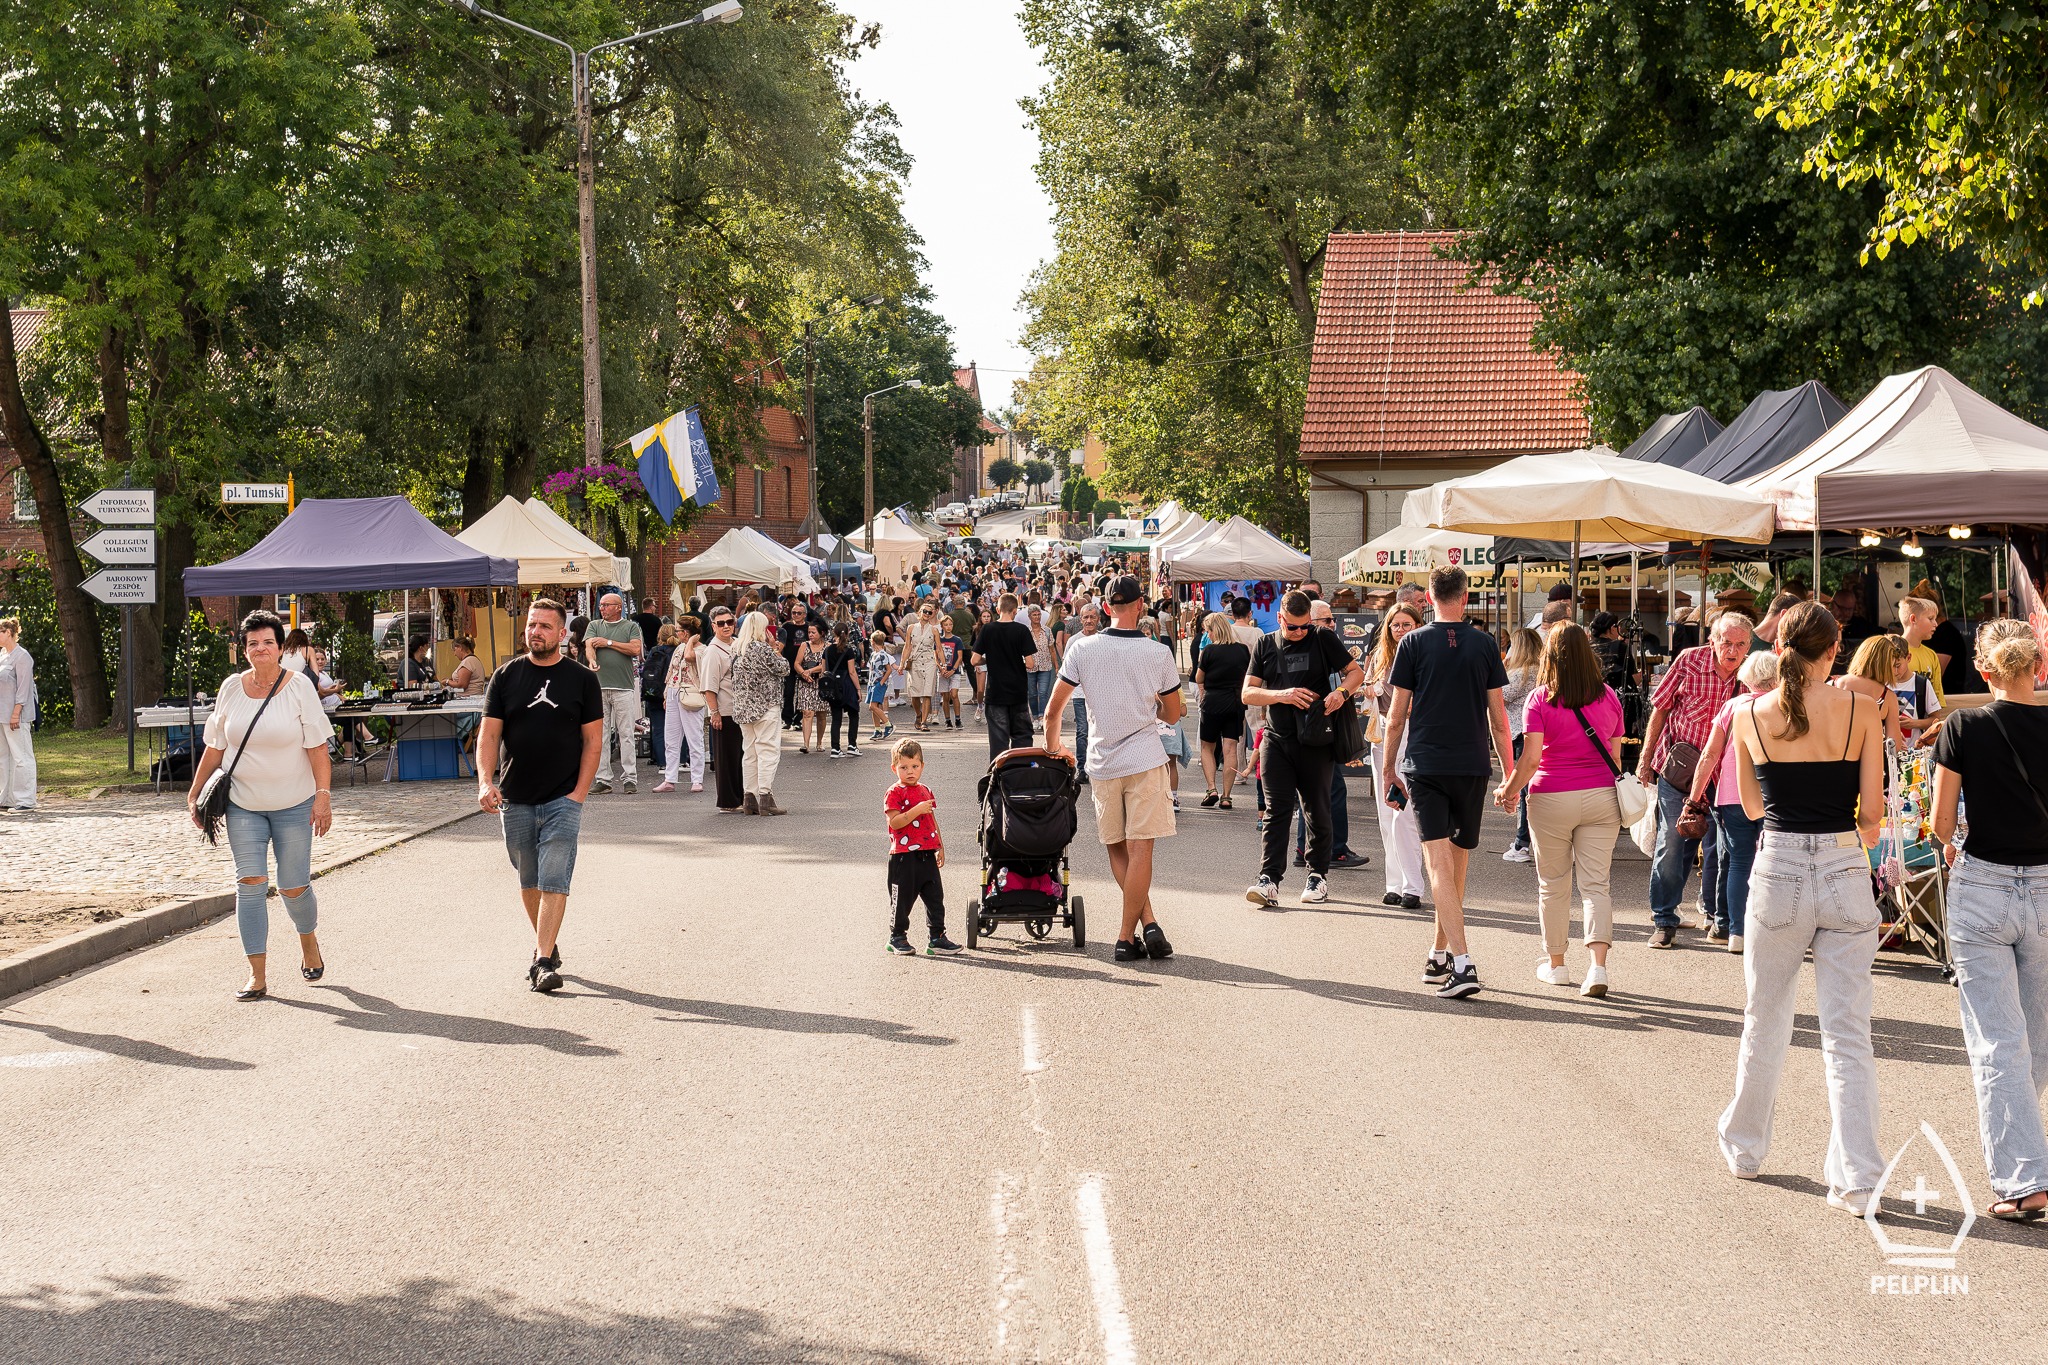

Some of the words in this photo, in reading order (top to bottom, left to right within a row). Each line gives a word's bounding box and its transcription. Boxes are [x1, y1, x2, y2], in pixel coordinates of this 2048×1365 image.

[226, 487, 241, 500] pl.
[244, 486, 285, 499] Tumski
[1390, 550, 1406, 566] LE
[1463, 547, 1497, 565] LEC
[113, 582, 141, 590] ZESPÓŁ
